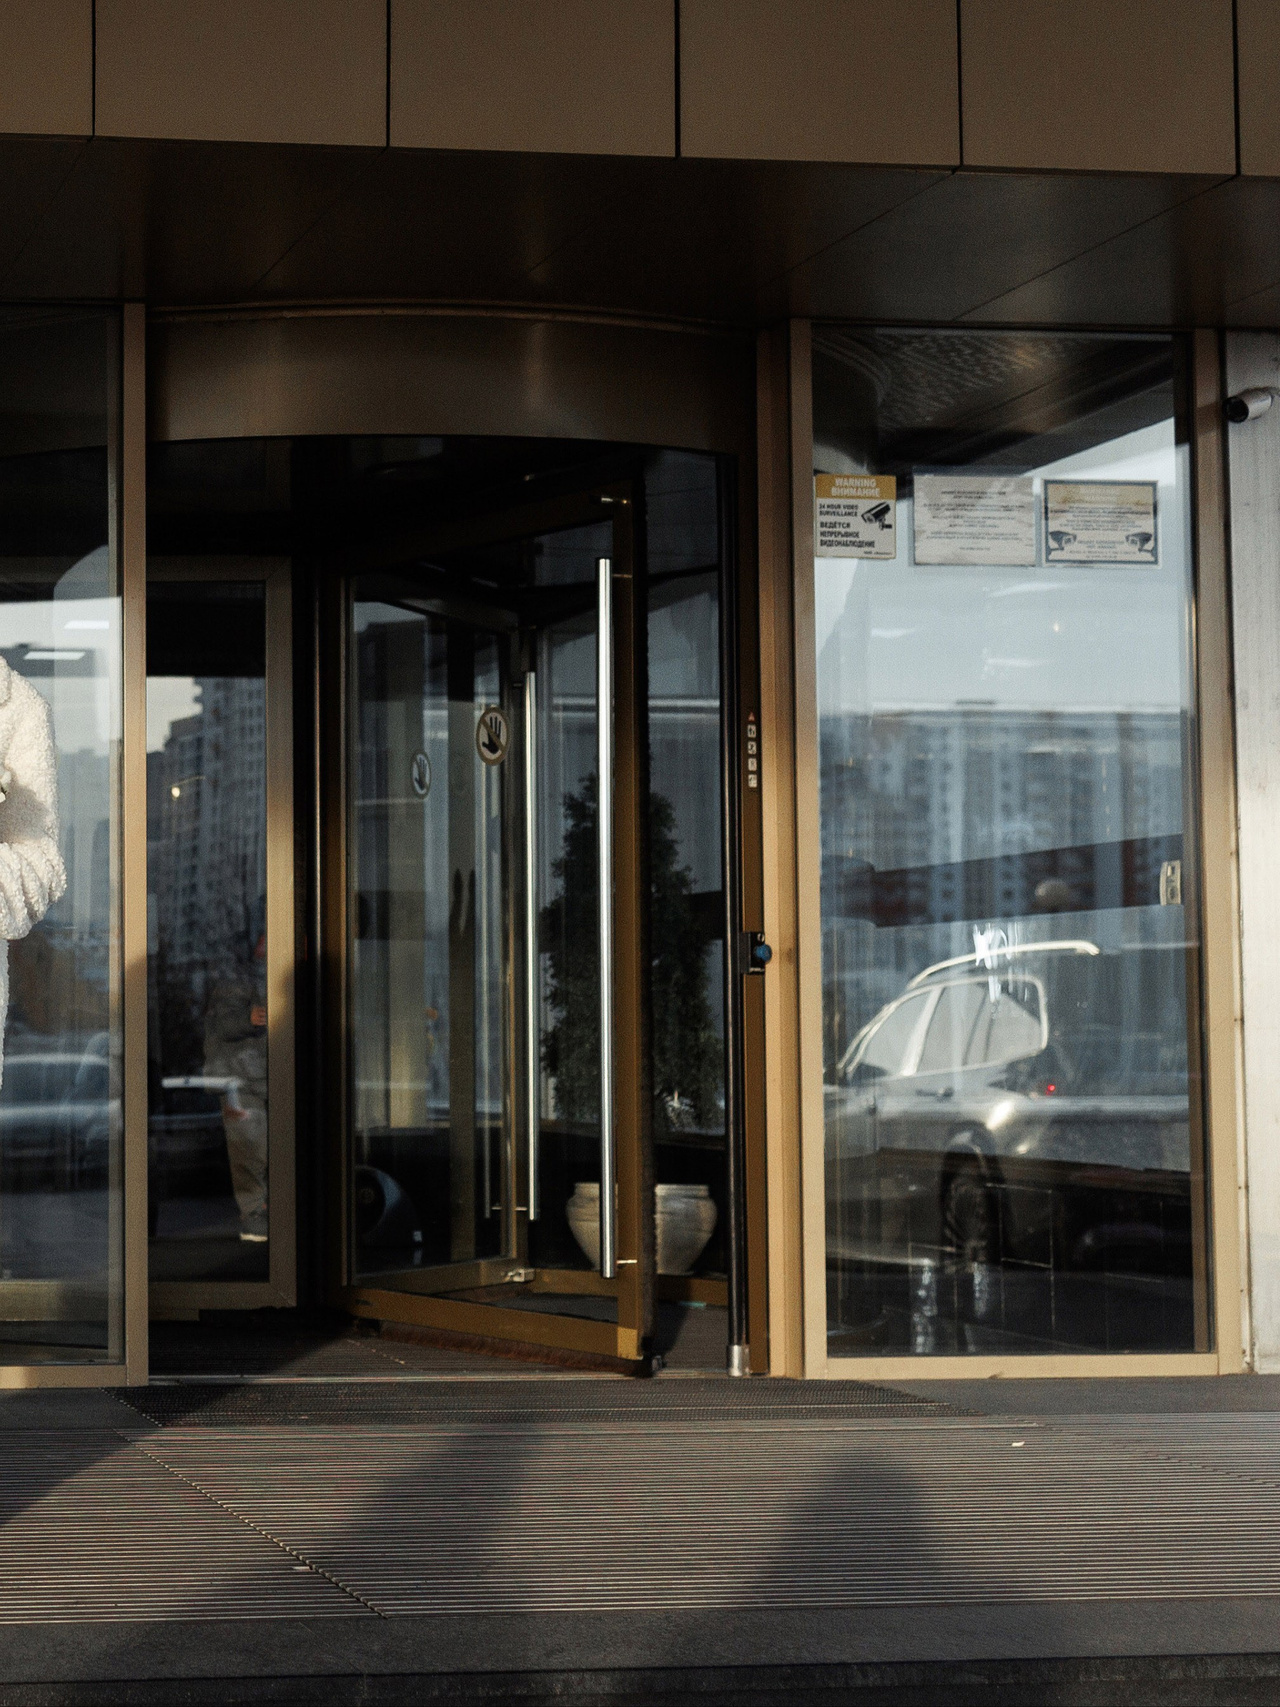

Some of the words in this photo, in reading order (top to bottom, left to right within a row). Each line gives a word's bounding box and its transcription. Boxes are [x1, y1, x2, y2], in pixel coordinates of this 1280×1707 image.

[835, 478, 877, 487] WARNING
[831, 487, 880, 497] ВНИМАНИЕ
[820, 521, 851, 529] ВЕДЁТСЯ
[820, 540, 875, 548] ВИДЕОНАБЛЮДЕНИЕ
